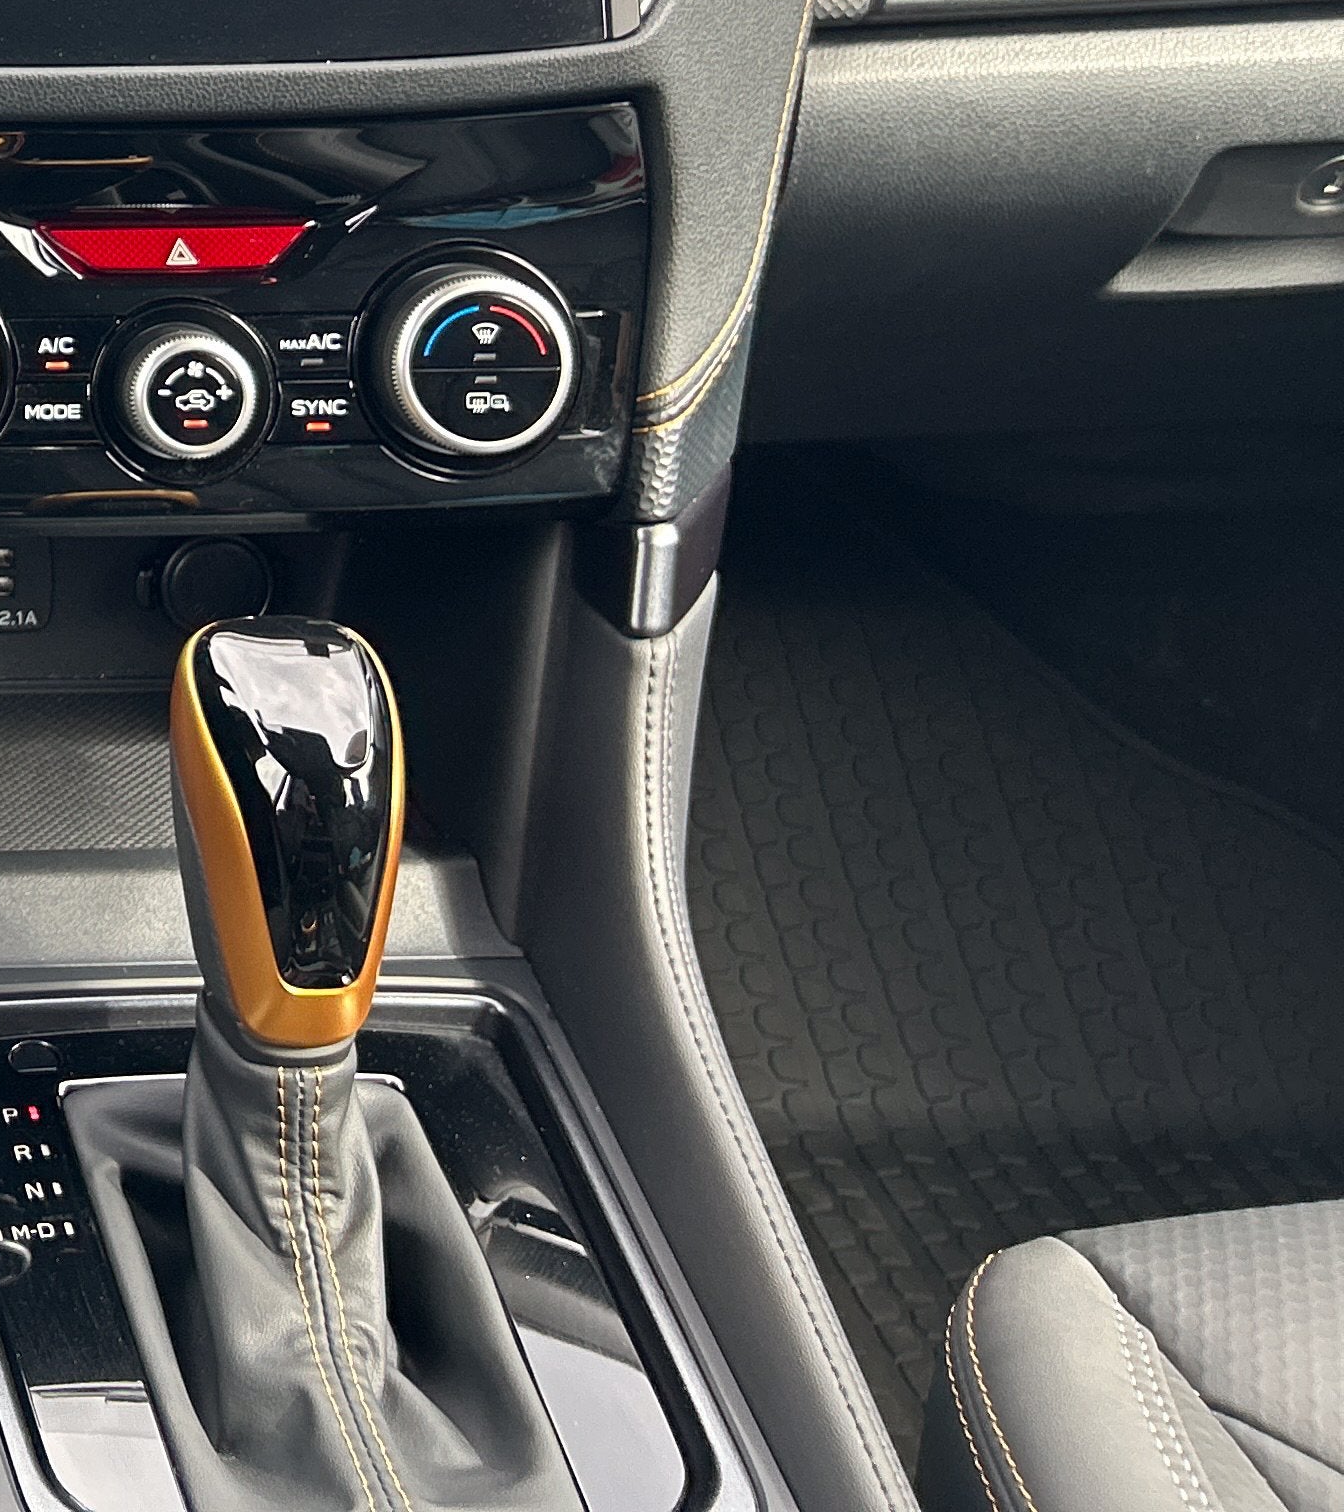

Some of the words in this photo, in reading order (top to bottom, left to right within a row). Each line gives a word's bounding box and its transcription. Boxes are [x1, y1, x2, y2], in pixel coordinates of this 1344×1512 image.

[37, 336, 75, 356] A/C
[24, 402, 82, 422] MODE
[291, 398, 349, 416] SYNC
[2, 1107, 18, 1124] P
[13, 1144, 33, 1162] R
[24, 1182, 45, 1201] N
